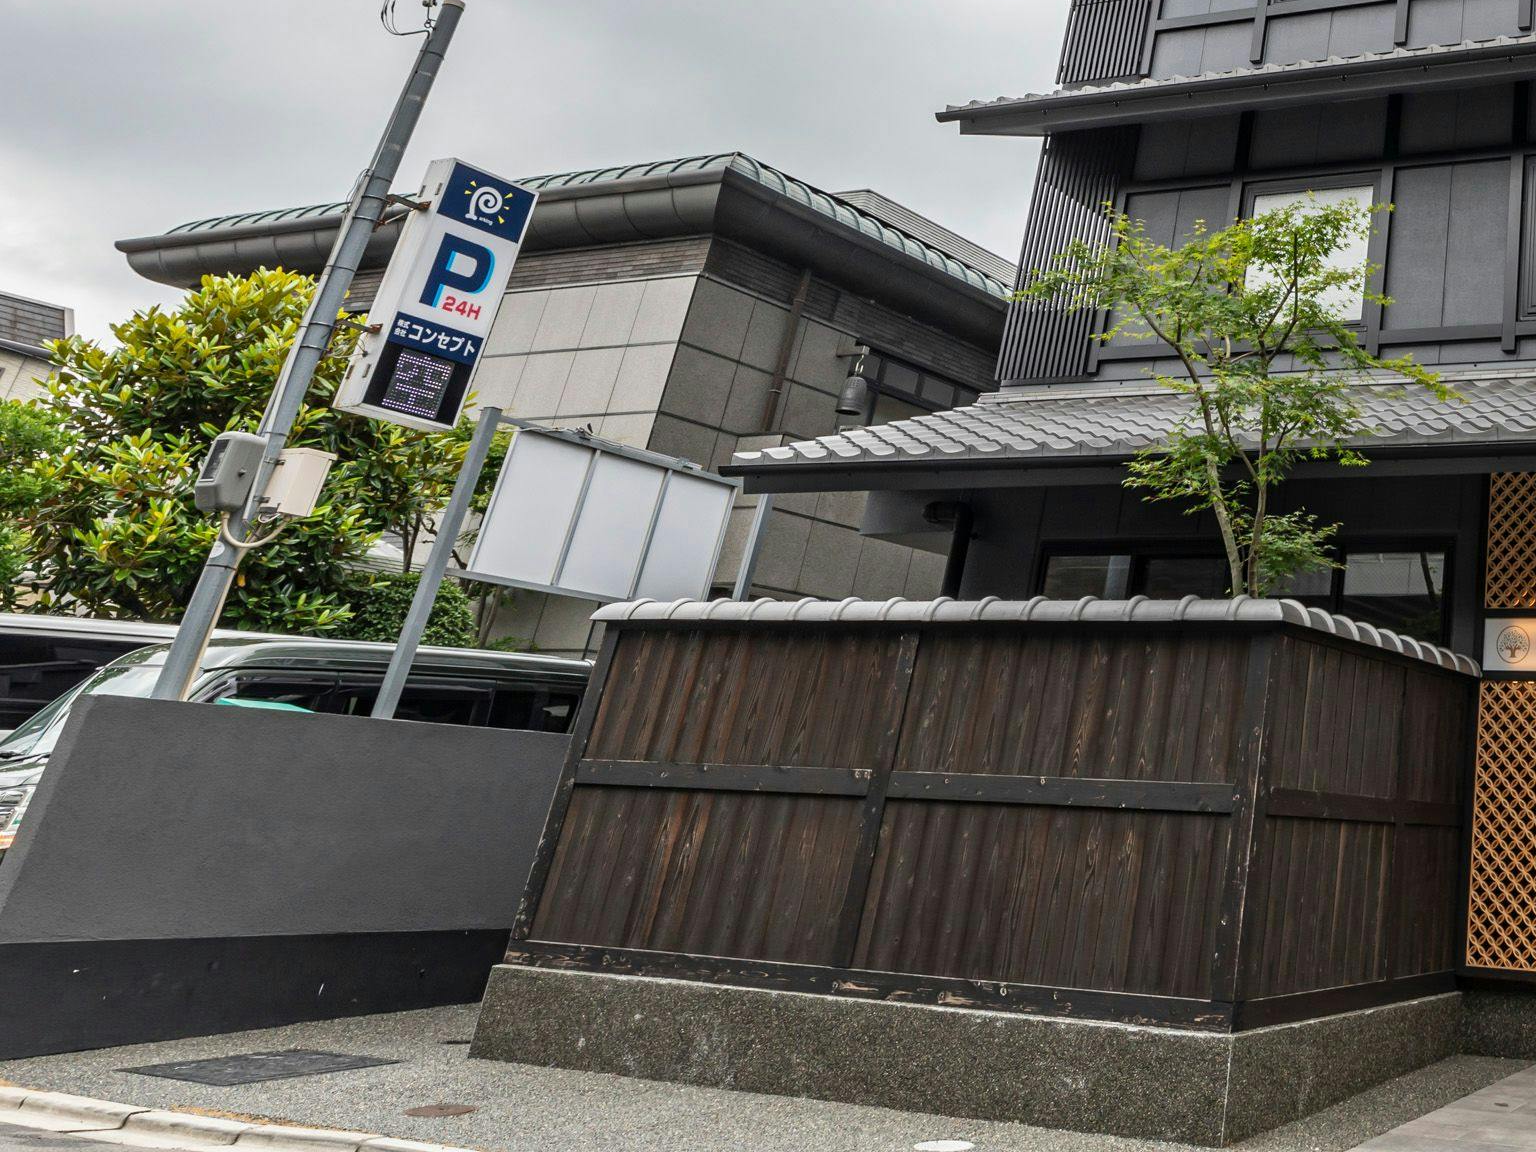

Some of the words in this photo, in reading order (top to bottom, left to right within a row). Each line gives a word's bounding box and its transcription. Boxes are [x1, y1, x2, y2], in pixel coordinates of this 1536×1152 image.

[419, 232, 496, 308] P
[442, 295, 482, 321] 24H
[408, 323, 477, 358] コンセプト
[382, 353, 451, 418] 空
